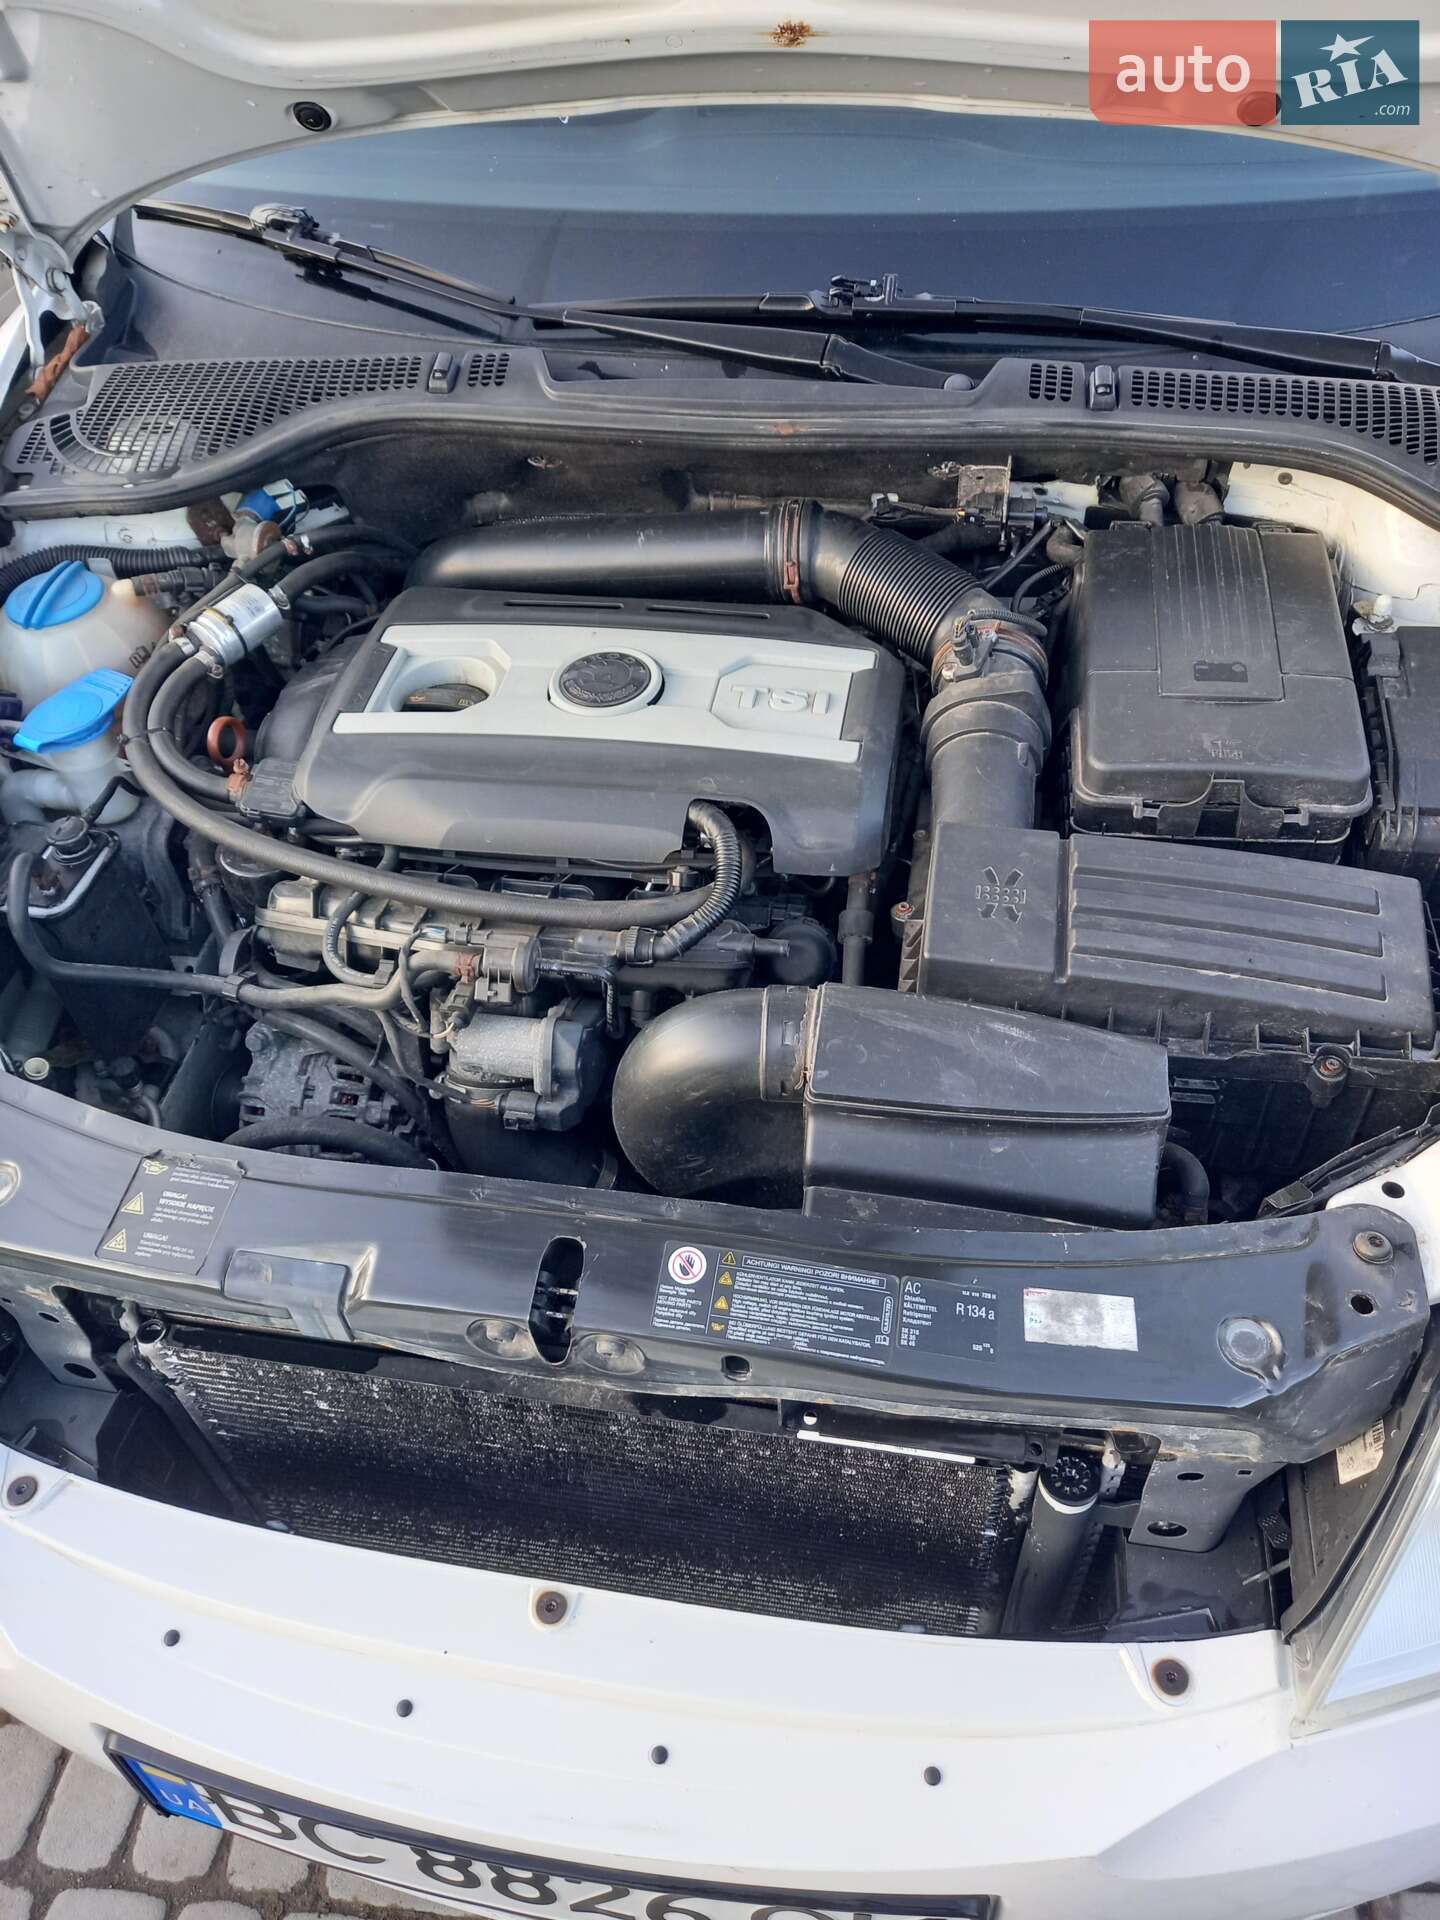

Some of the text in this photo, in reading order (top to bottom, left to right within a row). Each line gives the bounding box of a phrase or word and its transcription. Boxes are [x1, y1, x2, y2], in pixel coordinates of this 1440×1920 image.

[731, 684, 831, 714] TSI
[746, 1259, 780, 1269] ACHTUNG!
[781, 1265, 814, 1275] WARNING!
[814, 1270, 840, 1279] POZOR!
[904, 1281, 921, 1295] AC
[161, 1789, 210, 1815] UA
[205, 1786, 386, 1863] BC
